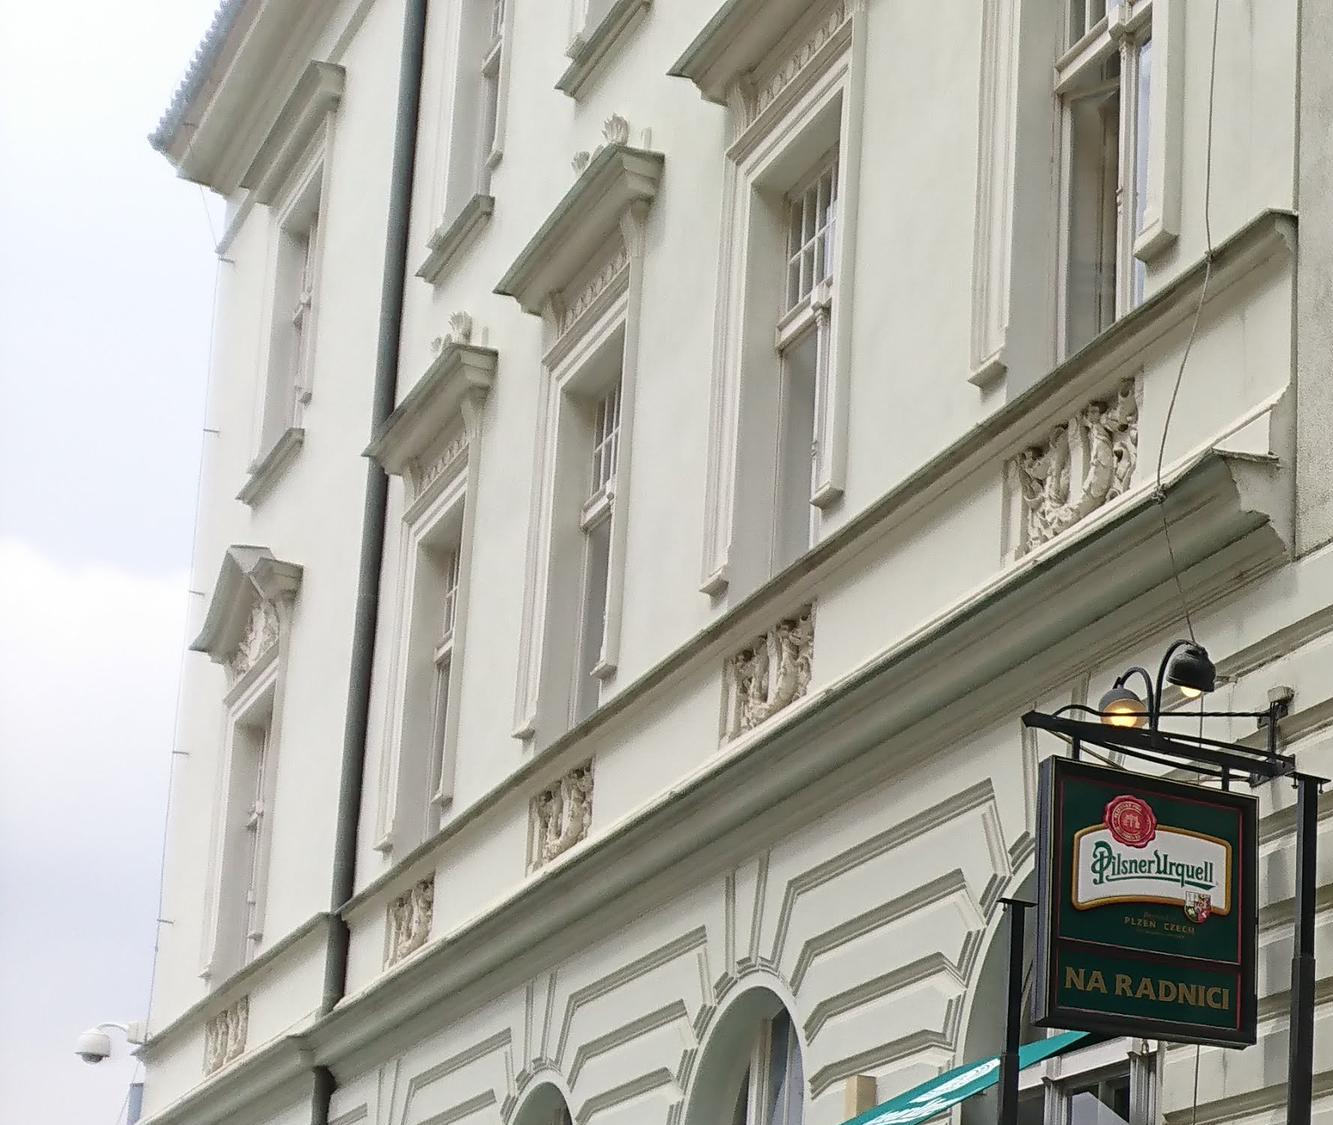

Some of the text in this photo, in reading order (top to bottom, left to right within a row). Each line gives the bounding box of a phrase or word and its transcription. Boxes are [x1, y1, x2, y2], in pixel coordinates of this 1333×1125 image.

[1091, 841, 1213, 888] Pilsner Urquell
[1064, 966, 1232, 1010] NA RADNICI
